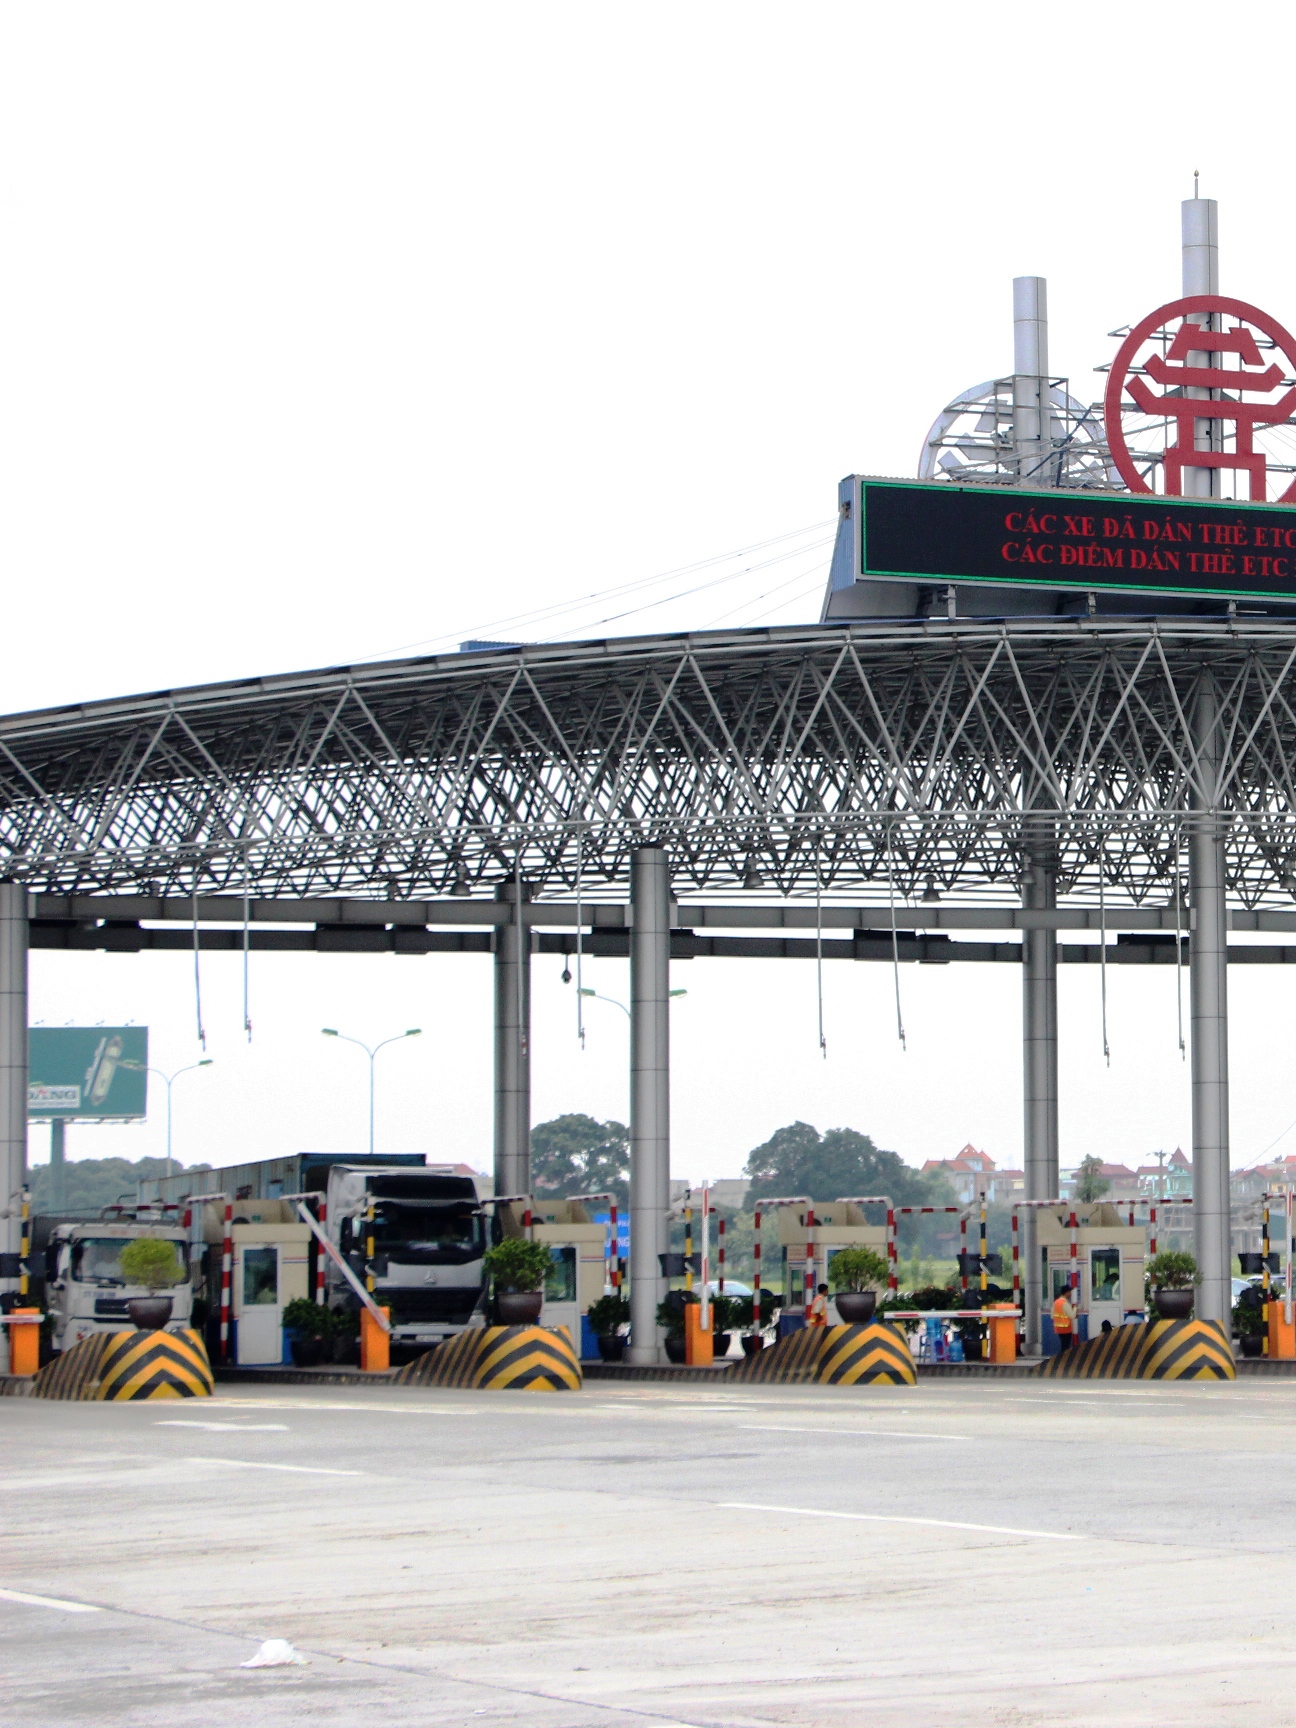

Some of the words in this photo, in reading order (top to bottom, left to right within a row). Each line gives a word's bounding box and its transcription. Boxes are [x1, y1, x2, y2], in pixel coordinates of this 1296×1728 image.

[1004, 508, 1057, 534] CÁC
[1063, 515, 1096, 537] XE
[1103, 514, 1137, 539] ĐÃ
[1143, 516, 1192, 542] DÁN
[1199, 520, 1248, 546] THẺ
[1001, 538, 1054, 564] CÁC
[1130, 545, 1180, 570] DÁN
[1187, 549, 1236, 574] THẺ
[1242, 555, 1289, 577] ETC
